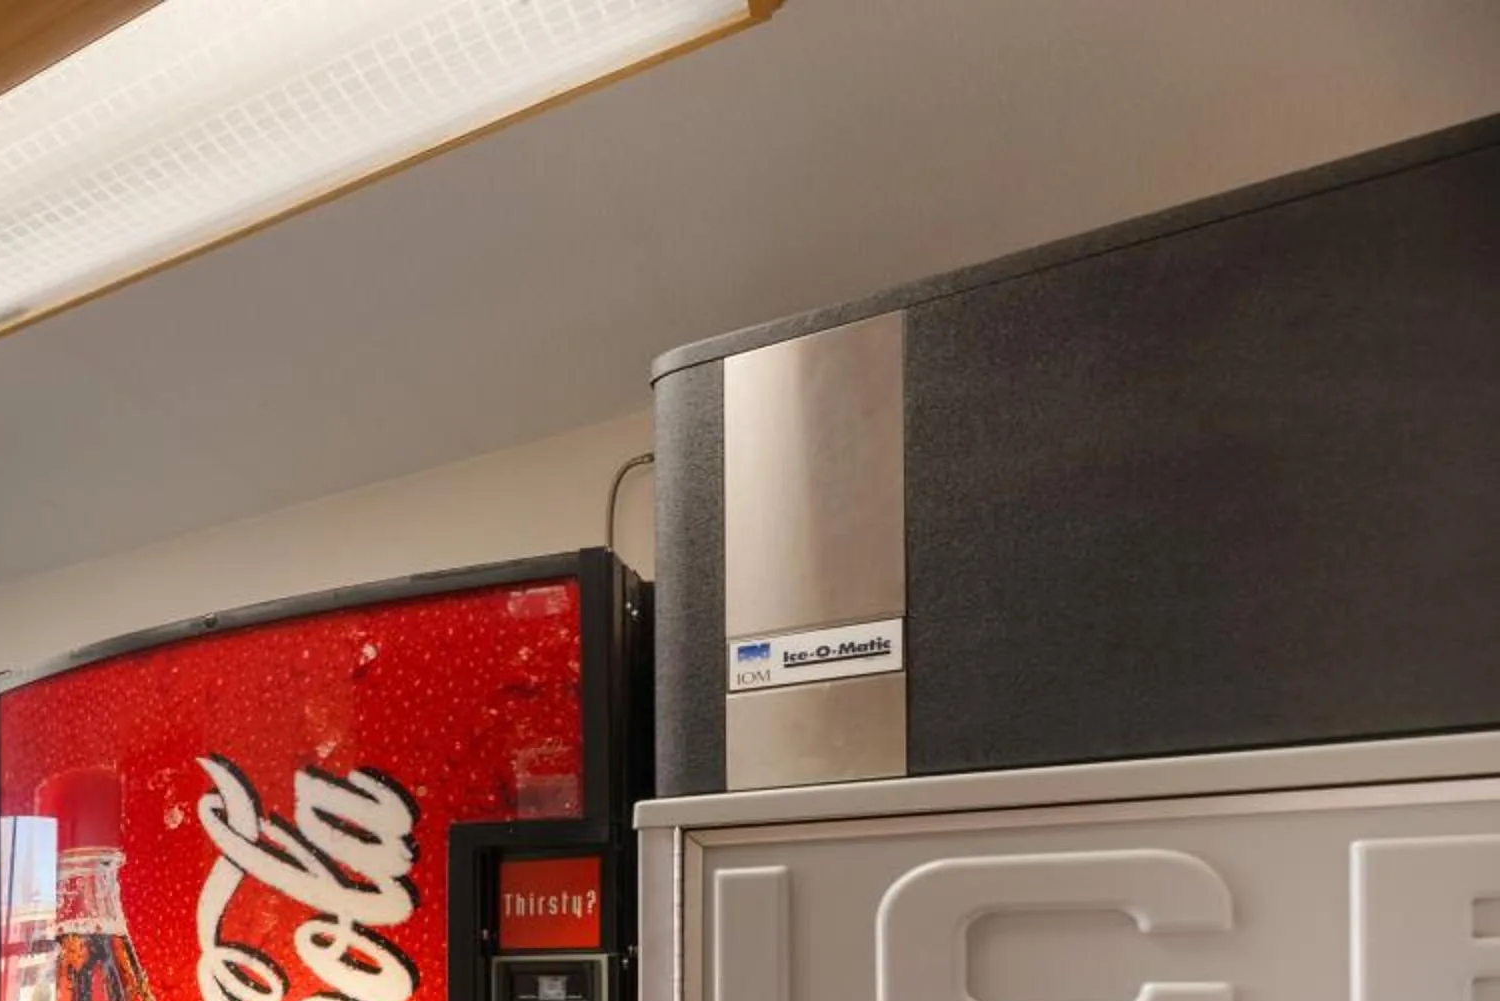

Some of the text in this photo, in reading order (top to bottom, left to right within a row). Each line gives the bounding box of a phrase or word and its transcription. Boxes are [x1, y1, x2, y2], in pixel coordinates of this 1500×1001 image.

[783, 636, 892, 663] Ice-O-Matic
[737, 669, 771, 686] IOM
[503, 889, 598, 918] Thirsty?
